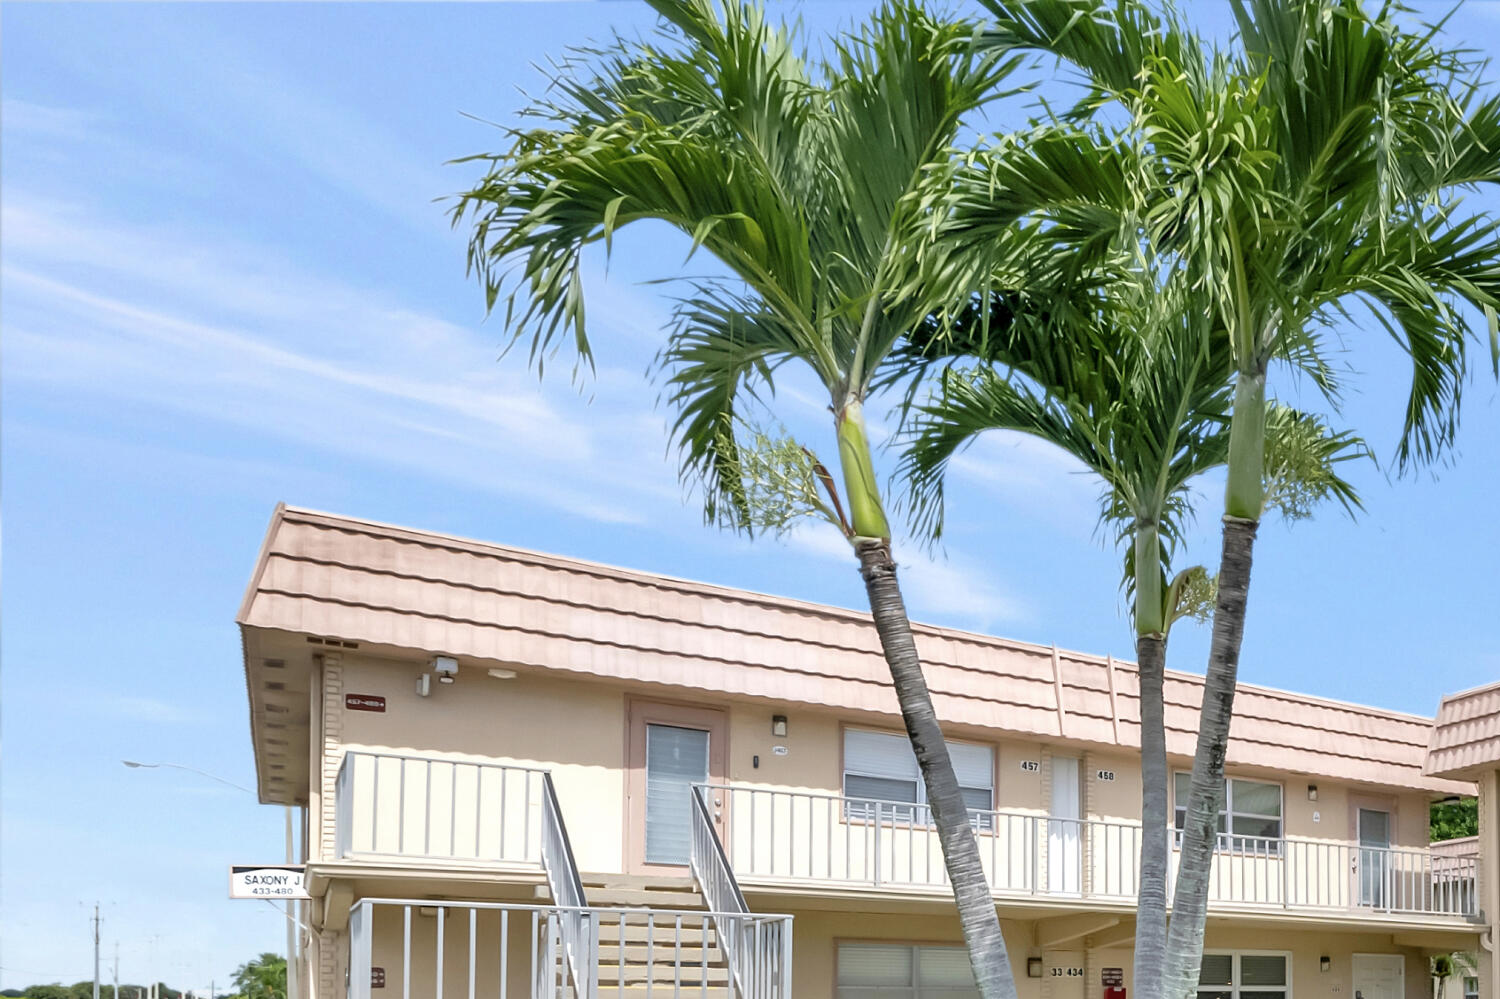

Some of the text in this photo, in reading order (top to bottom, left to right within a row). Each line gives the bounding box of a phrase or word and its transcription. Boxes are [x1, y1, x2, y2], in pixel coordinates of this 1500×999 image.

[1021, 761, 1039, 771] 457
[1097, 771, 1114, 780] 458
[244, 875, 300, 885] SAXONY J
